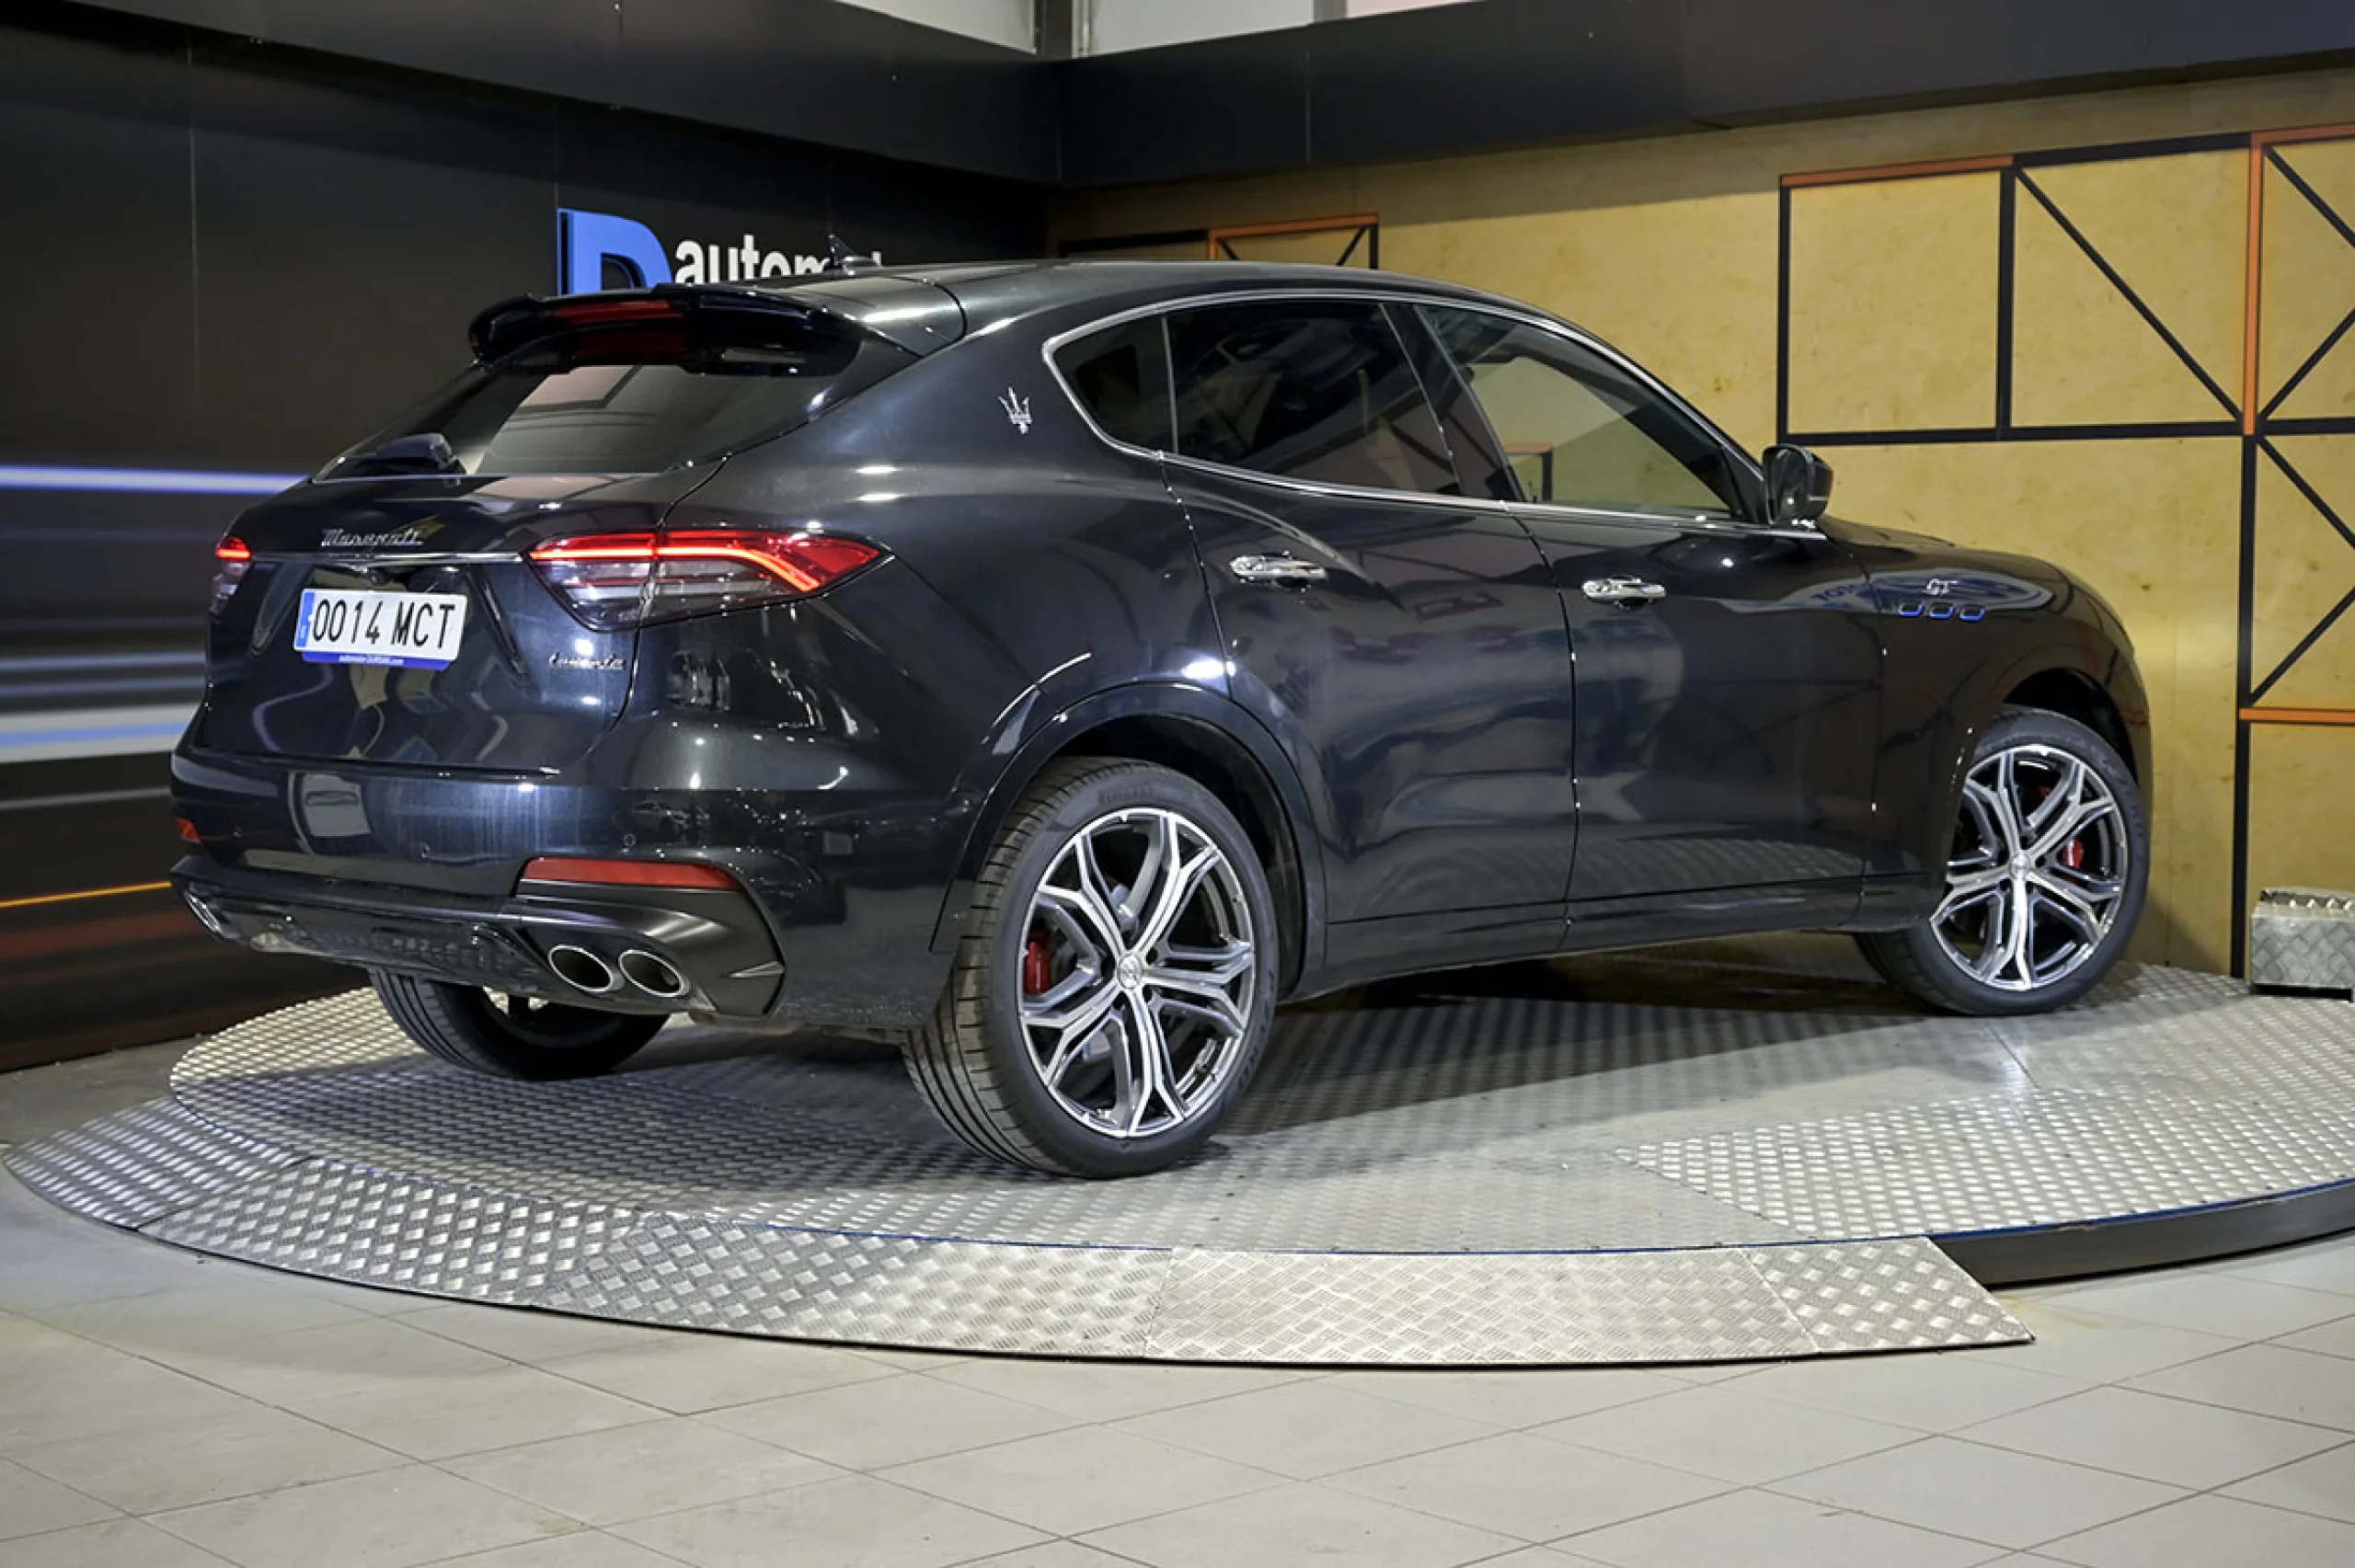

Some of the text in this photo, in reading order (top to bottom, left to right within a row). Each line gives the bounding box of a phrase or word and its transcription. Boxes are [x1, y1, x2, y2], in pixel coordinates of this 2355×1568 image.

[321, 527, 424, 546] Maserati
[1924, 578, 1959, 597] GT
[313, 598, 456, 649] 0014 MCT
